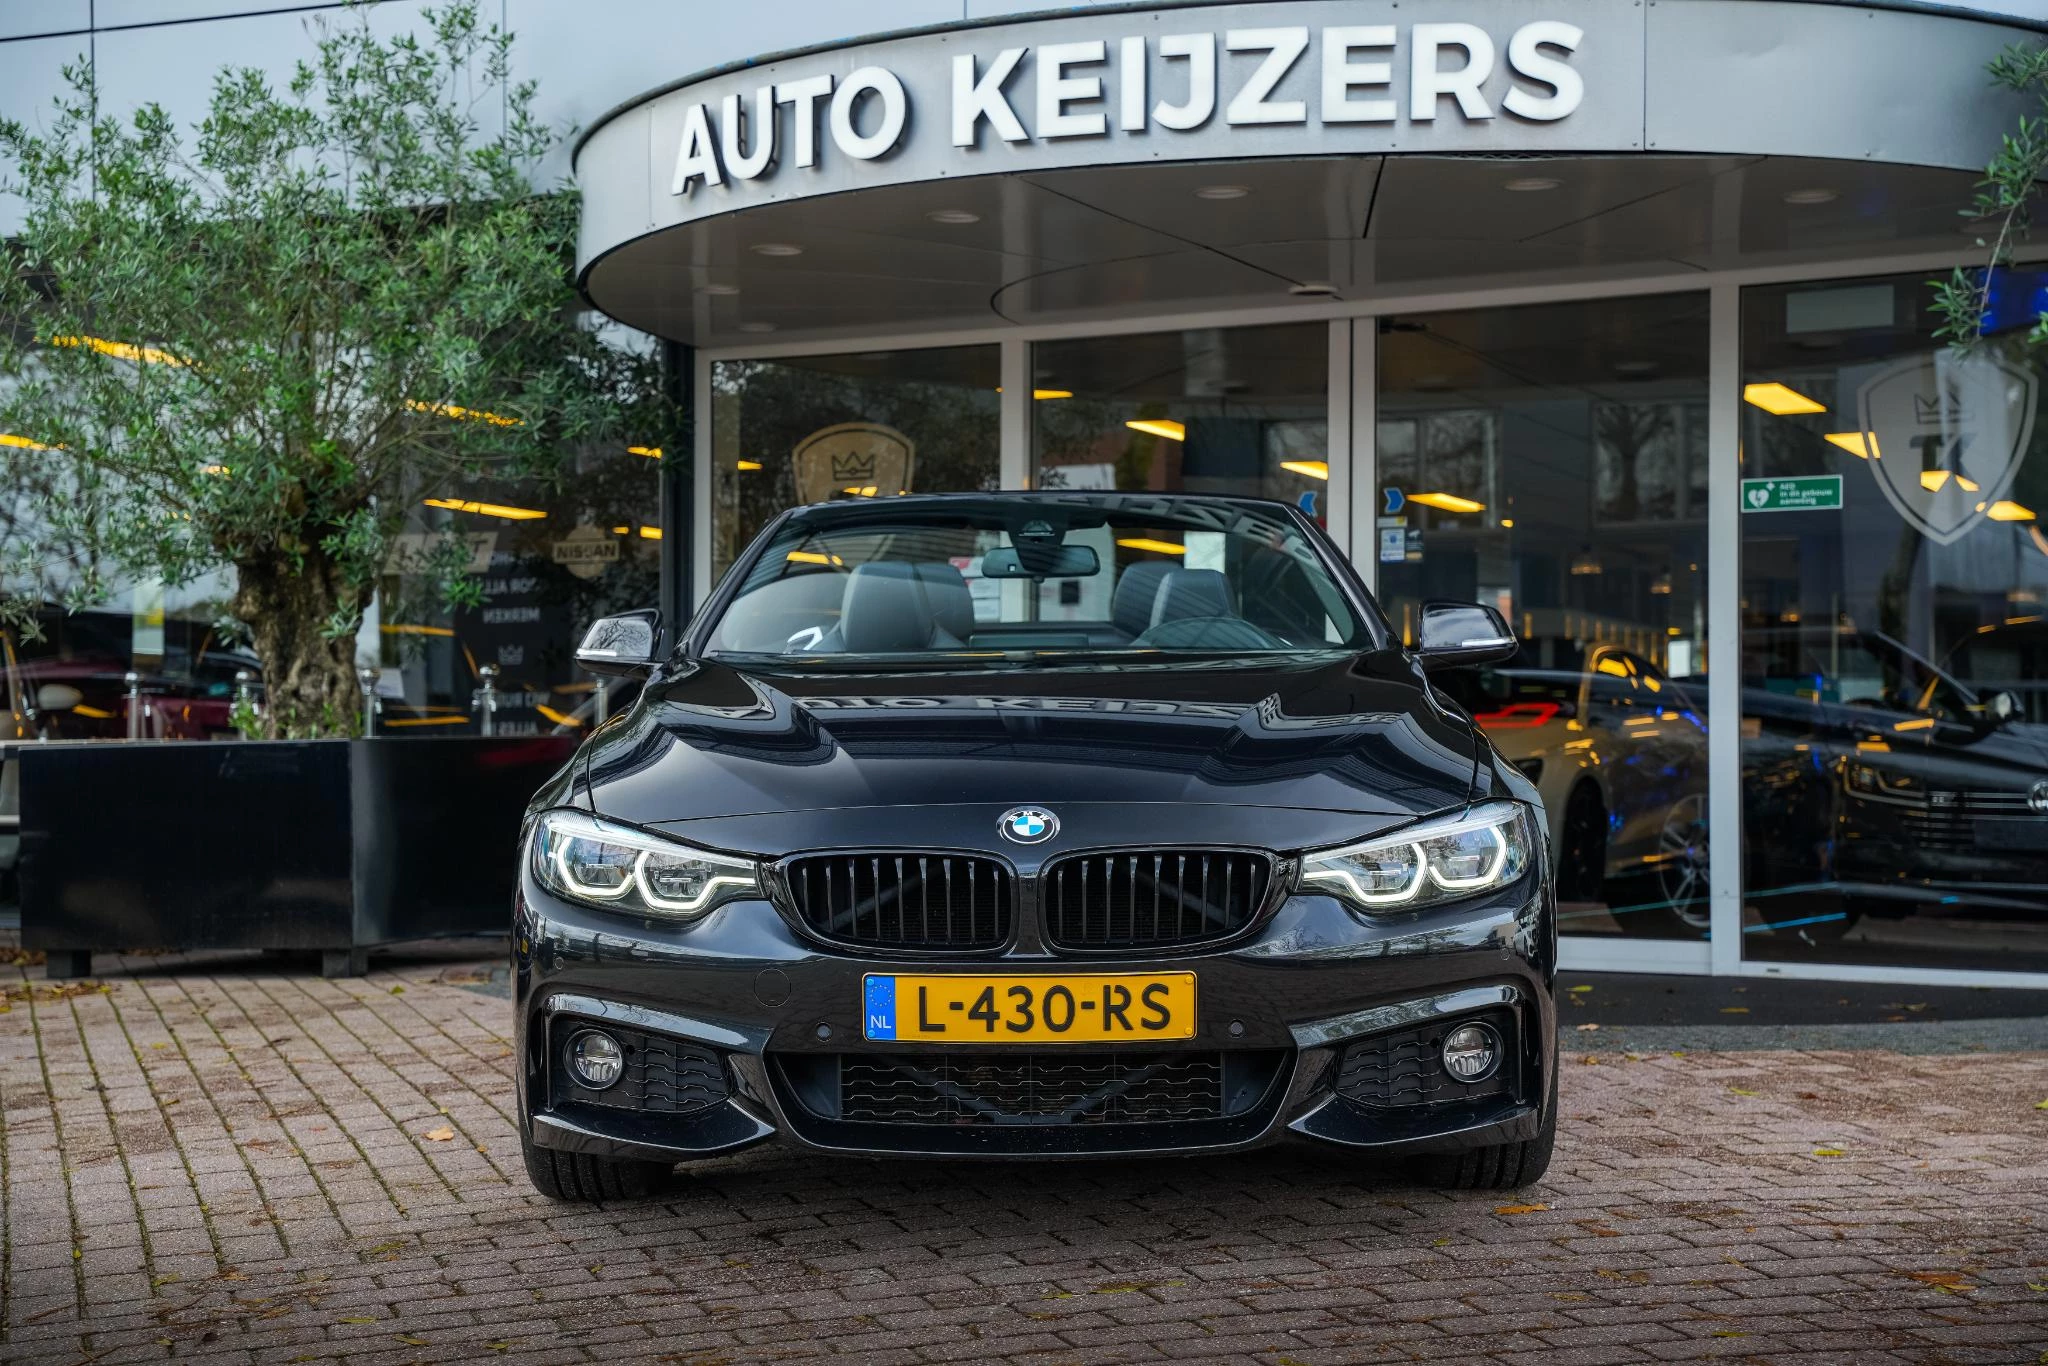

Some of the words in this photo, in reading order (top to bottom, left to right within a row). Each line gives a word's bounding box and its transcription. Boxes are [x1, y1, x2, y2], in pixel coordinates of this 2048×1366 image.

[672, 64, 910, 196] AUTO
[951, 20, 1585, 149] KEIJZERS
[1801, 488, 1833, 499] gebouw
[1006, 810, 1050, 822] BMW
[918, 983, 1172, 1033] L-430-RS
[870, 1015, 892, 1029] NL
